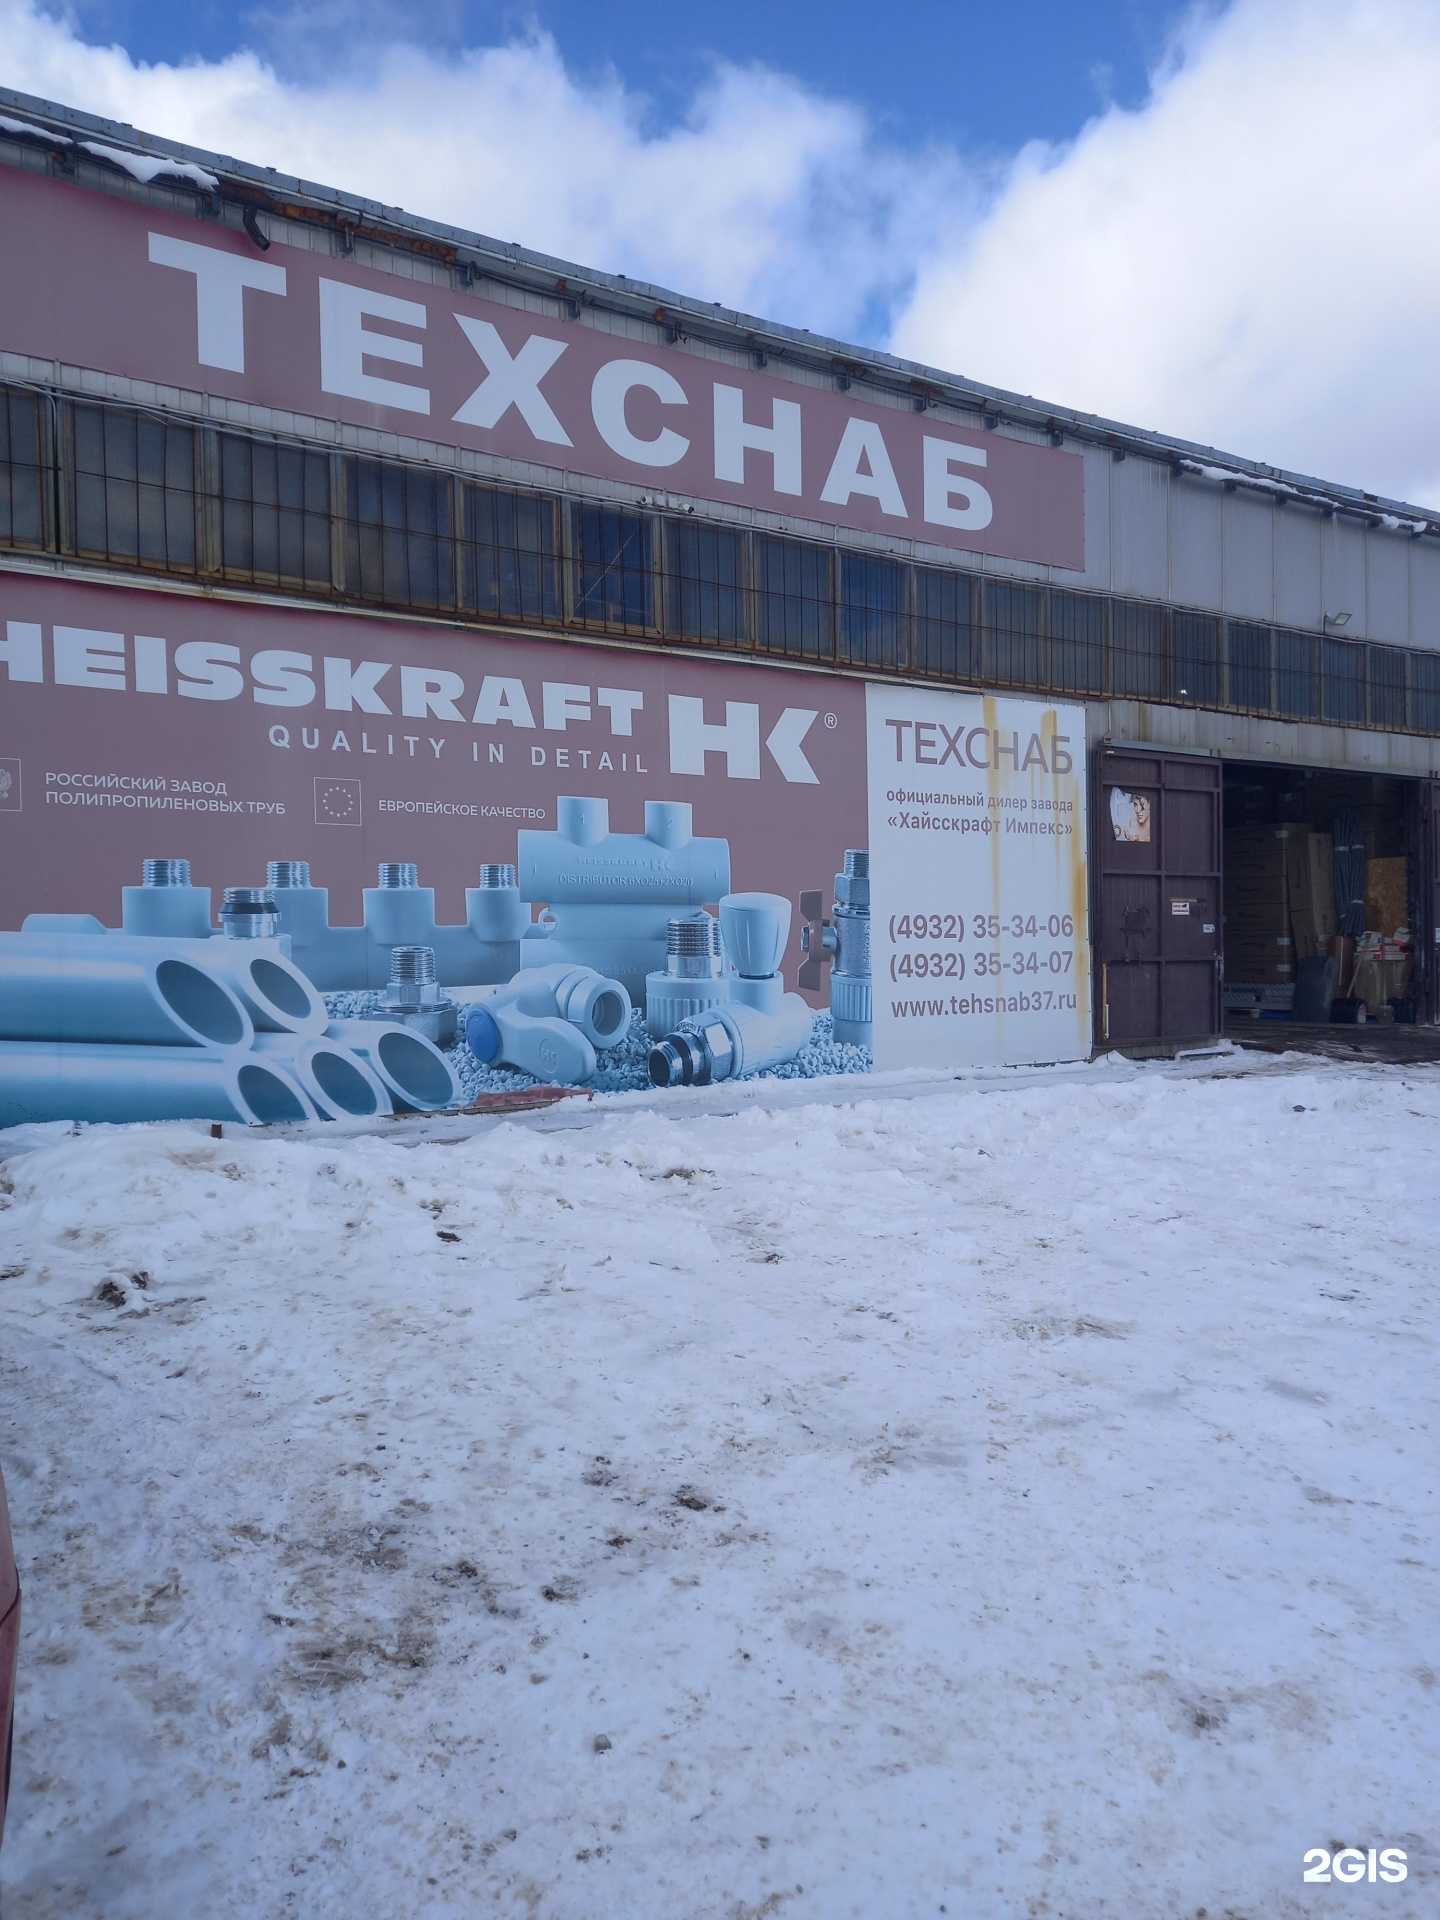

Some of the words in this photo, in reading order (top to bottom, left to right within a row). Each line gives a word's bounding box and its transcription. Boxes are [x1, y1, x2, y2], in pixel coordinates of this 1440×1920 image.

[148, 231, 993, 531] ТЕХСНАБ
[268, 724, 446, 759] QUALITY
[472, 741, 505, 764] IN
[530, 746, 648, 773] DETAIL
[668, 694, 822, 785] HK
[885, 718, 1073, 775] ТЕХСНАБ
[45, 772, 167, 792] РОССИЙСКИЙ
[170, 779, 228, 796] ЗАВОД
[46, 791, 243, 813] ПОЛИПРОПИЛЕНОВЫХ
[246, 801, 286, 815] ТРУБ
[378, 799, 478, 816] ЕВРОПЕЙСКОЕ
[480, 805, 546, 819] КАЧЕСТВО
[886, 788, 984, 808] официальный
[988, 796, 1028, 811] дилер
[1031, 799, 1073, 812] завода
[887, 811, 1001, 835] «Хайсскрафт
[1005, 818, 1073, 836] Импекс»
[888, 914, 965, 943] (4932)
[972, 913, 1074, 939] 35-34-06
[889, 952, 966, 982] (4932)
[973, 950, 1073, 977] 35-34-07
[891, 990, 1077, 1018] www.tehsnab37.ru
